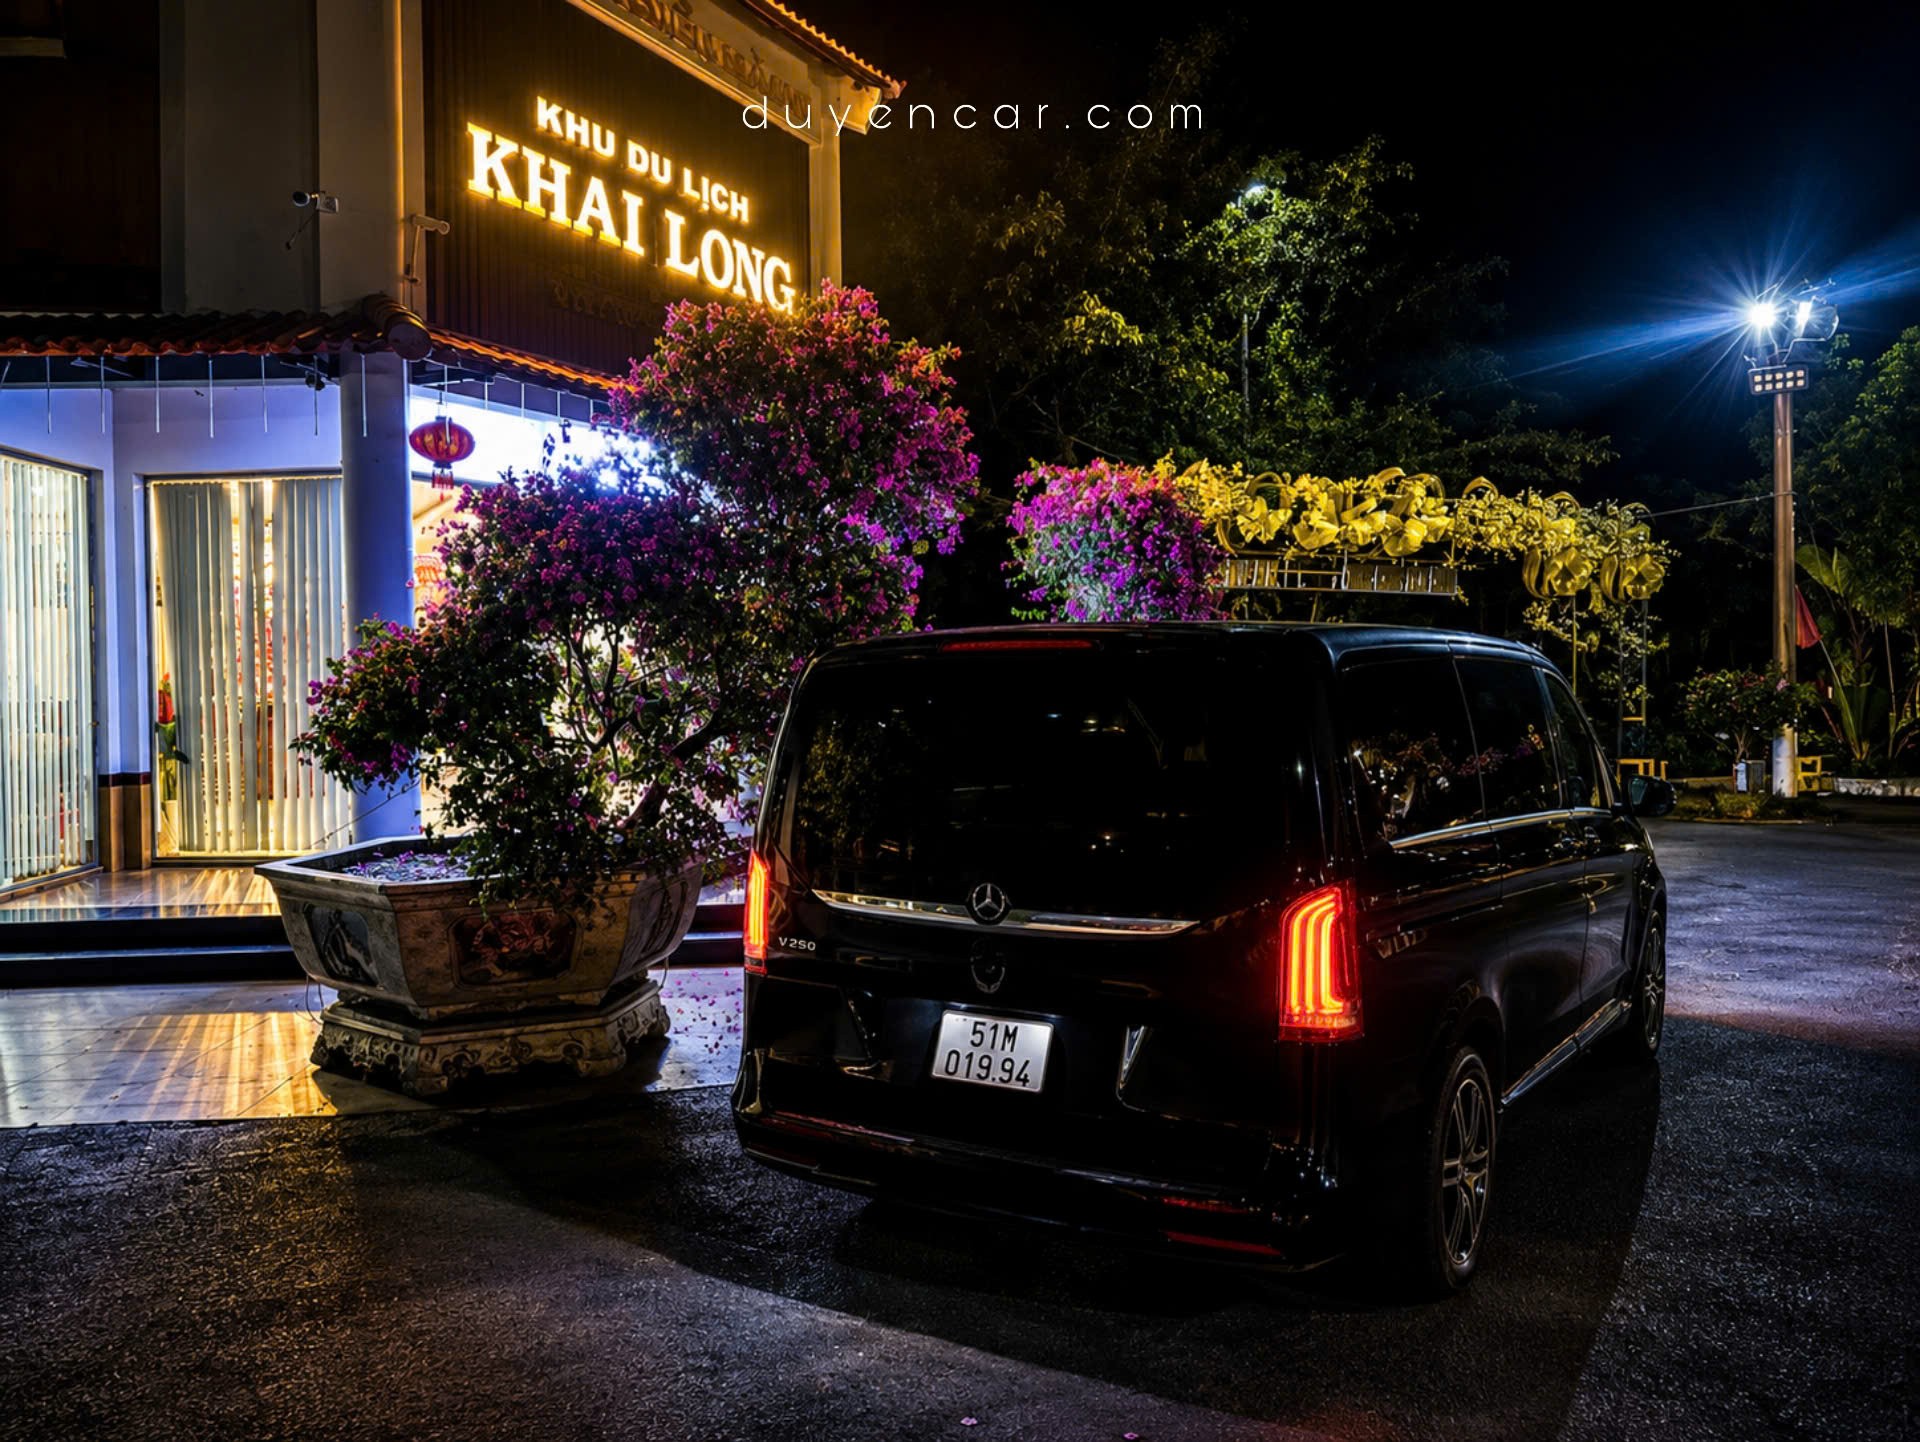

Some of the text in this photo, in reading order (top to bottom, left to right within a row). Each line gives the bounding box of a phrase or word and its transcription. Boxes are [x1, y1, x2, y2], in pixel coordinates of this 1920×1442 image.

[536, 95, 750, 224] KHU DU LỊCH
[467, 122, 645, 257] KHAI
[664, 208, 796, 314] LONG
[778, 936, 817, 951] V250
[970, 1021, 1018, 1053] 51M
[944, 1049, 1030, 1087] 019.94
